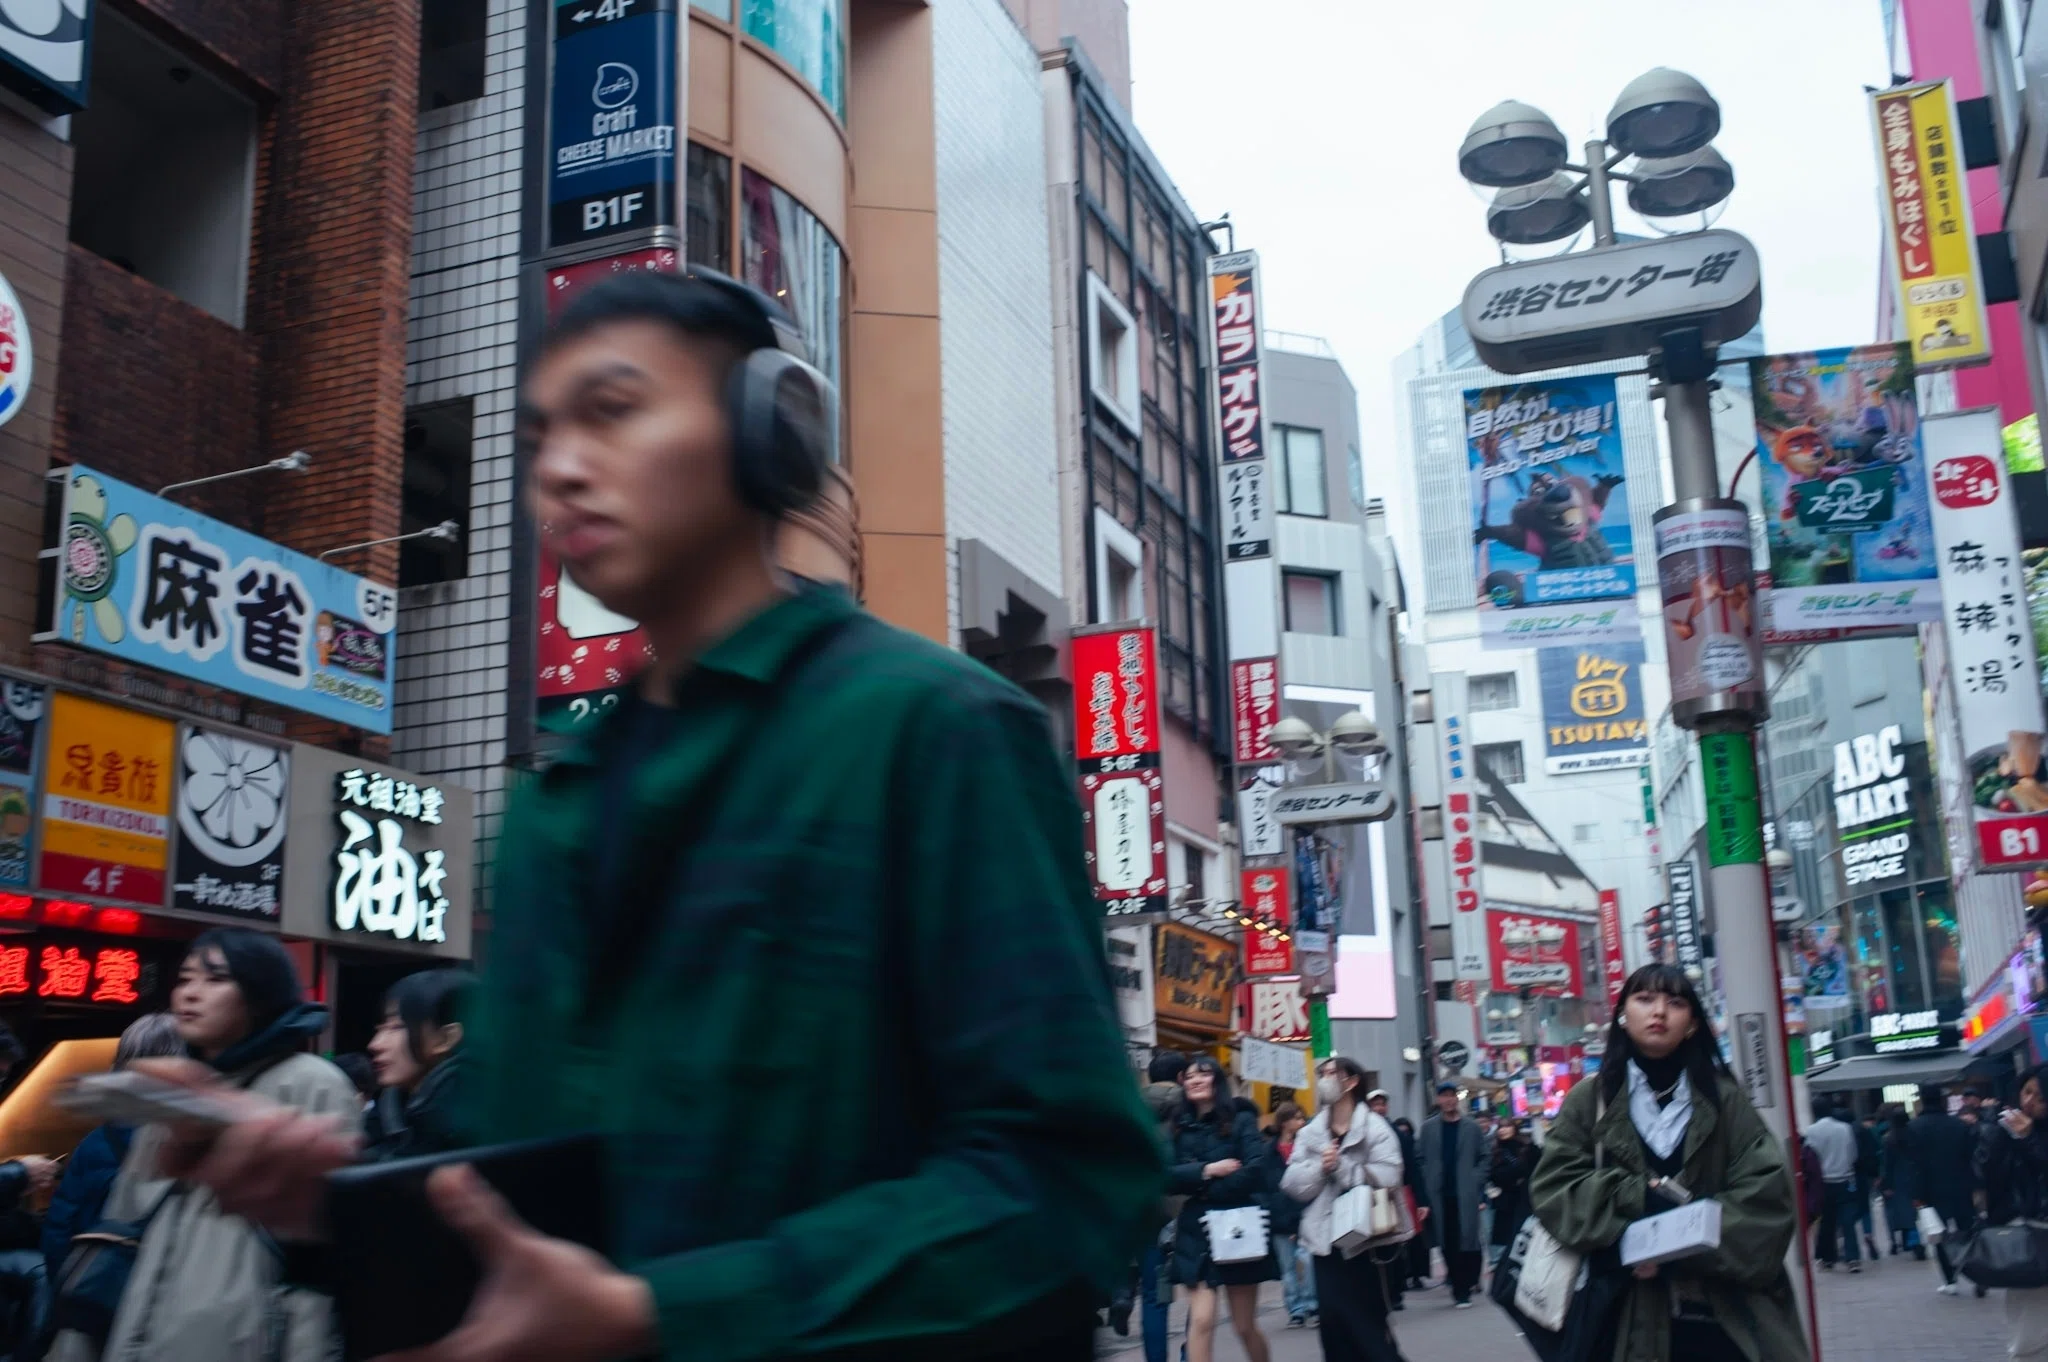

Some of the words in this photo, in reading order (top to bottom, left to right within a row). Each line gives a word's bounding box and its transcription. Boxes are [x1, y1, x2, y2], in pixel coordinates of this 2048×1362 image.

[557, 138, 606, 165] CHEESE
[605, 125, 675, 160] MARKET
[1882, 101, 1929, 274] 全身もみほぐし
[582, 191, 644, 231] B1F
[1479, 250, 1742, 321] 渋谷センター街
[141, 536, 306, 680] 麻雀
[363, 588, 393, 620] 5F
[1832, 723, 1906, 793] ABC
[340, 768, 446, 825] 元祖油堂
[1273, 789, 1385, 814] 渋谷センター街
[1834, 776, 1911, 830] MART
[1842, 831, 1911, 866] GRAND
[1999, 826, 2040, 858] B1
[82, 863, 126, 893] 4F
[1845, 854, 1907, 886] STAGE
[1252, 982, 1311, 1038] 豚
